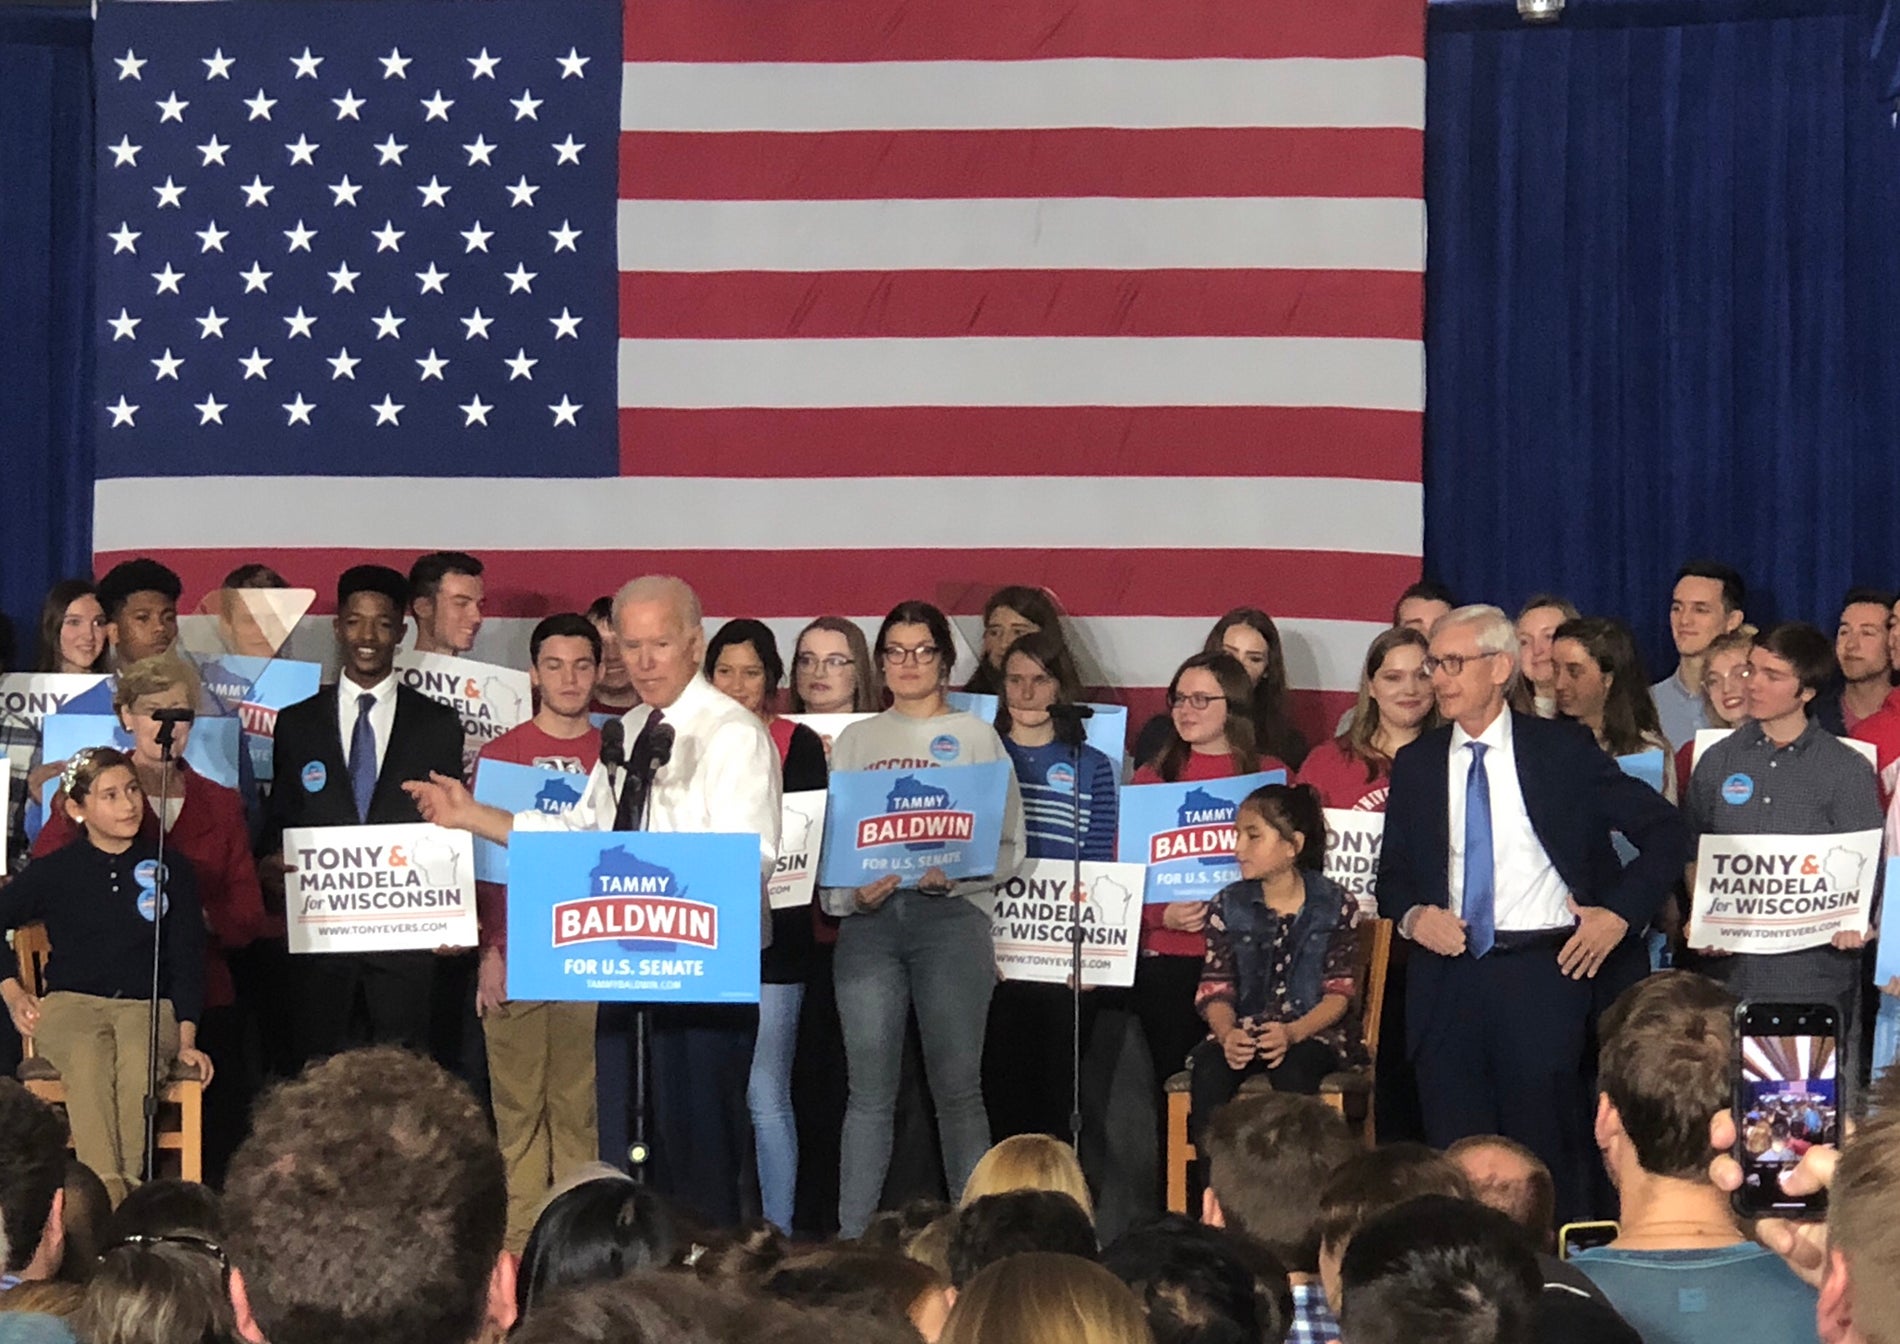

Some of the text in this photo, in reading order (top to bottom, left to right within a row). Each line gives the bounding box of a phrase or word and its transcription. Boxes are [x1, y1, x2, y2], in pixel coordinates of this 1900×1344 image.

[464, 678, 481, 699] &
[0, 692, 68, 714] ONY
[892, 795, 944, 810] TAMMY
[1185, 808, 1234, 823] TAMMY
[862, 816, 970, 843] BALDWIN
[1155, 829, 1239, 859] BALDW
[1324, 829, 1382, 854] ONY
[299, 845, 408, 870] TONY &
[862, 858, 888, 870] FOR
[891, 856, 915, 869] U.S.
[1713, 854, 1820, 875] TONY &
[300, 869, 421, 891] MANDELA
[600, 875, 669, 892] TAMMY
[1156, 872, 1182, 884] FOR
[1709, 877, 1828, 895] MANDELA
[302, 888, 461, 915] for WISCONSIN
[1706, 890, 1860, 914] for WISCONSIN
[318, 922, 447, 935] WWW.TONYEVERS.COM
[561, 904, 710, 939] BALDWIN
[1720, 921, 1841, 938] WWW.TONYEVERS.COM
[564, 959, 704, 976] FOR U.S. SENATE
